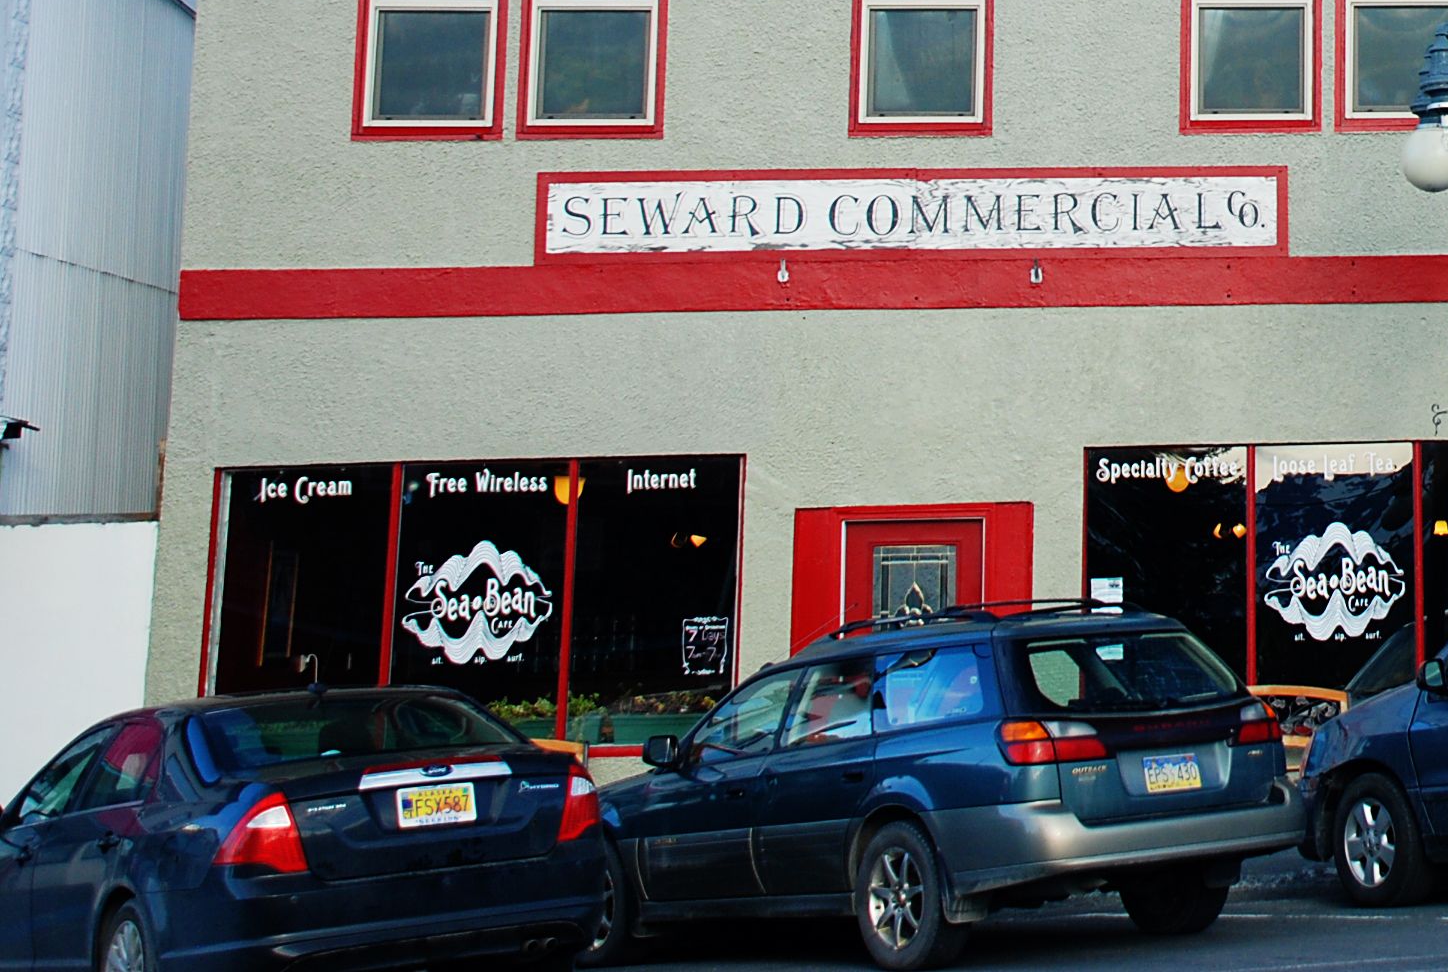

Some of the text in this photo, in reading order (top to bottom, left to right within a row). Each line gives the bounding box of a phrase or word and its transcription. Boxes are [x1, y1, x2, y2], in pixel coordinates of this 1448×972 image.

[561, 191, 806, 239] SEWARD
[828, 189, 1223, 237] COMMERCIAL
[627, 468, 697, 495] Internet
[1096, 456, 1238, 484] Specialty Coffee
[1273, 451, 1393, 483] Loose Leaf Tea
[260, 476, 353, 504] Ice Cream
[426, 468, 548, 498] Free Wireless
[1340, 557, 1391, 596] Bean
[483, 578, 537, 618] Bean
[688, 629, 698, 643] 7
[414, 794, 470, 818] FSX587
